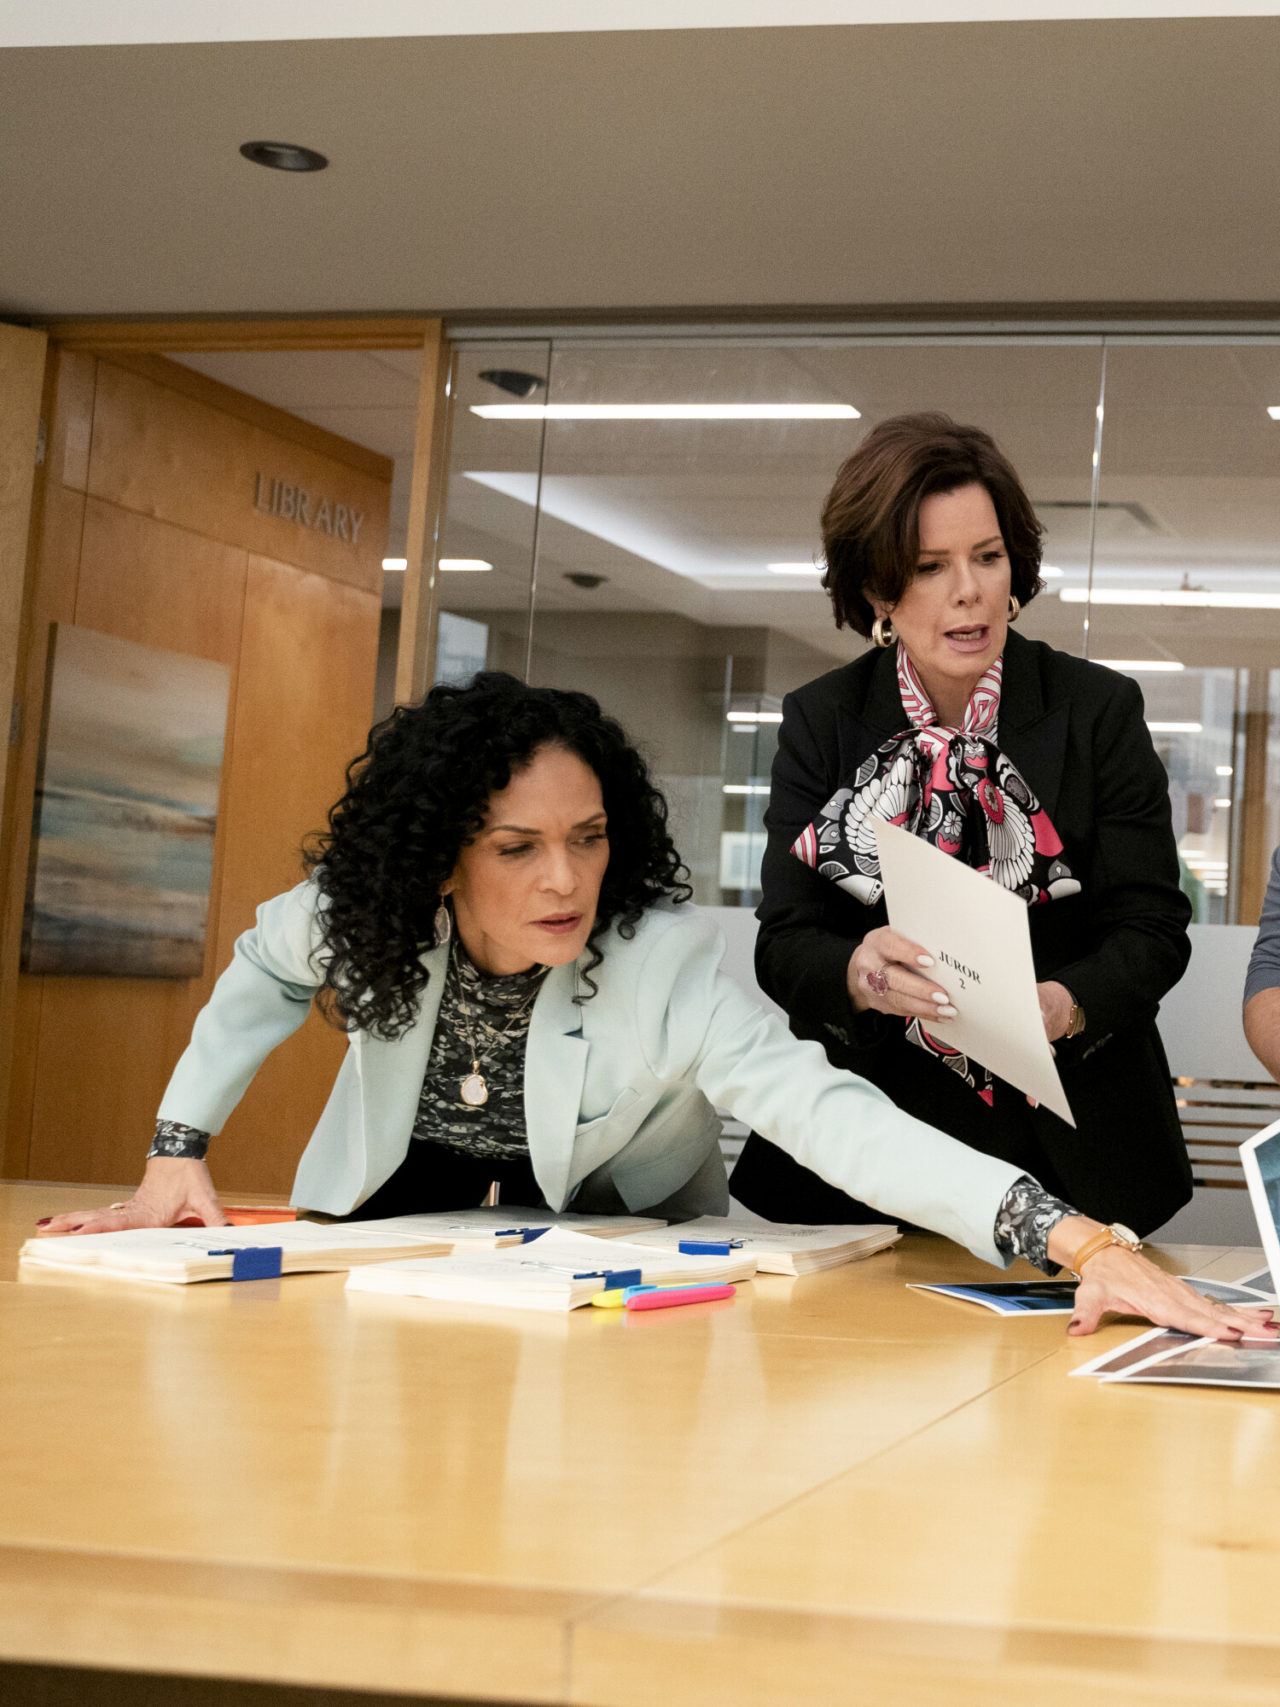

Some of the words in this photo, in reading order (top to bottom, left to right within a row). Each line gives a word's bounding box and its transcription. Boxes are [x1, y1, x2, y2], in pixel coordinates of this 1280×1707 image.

[254, 471, 365, 544] LIBRARY
[939, 950, 981, 984] JUROR
[959, 978, 966, 990] 2
